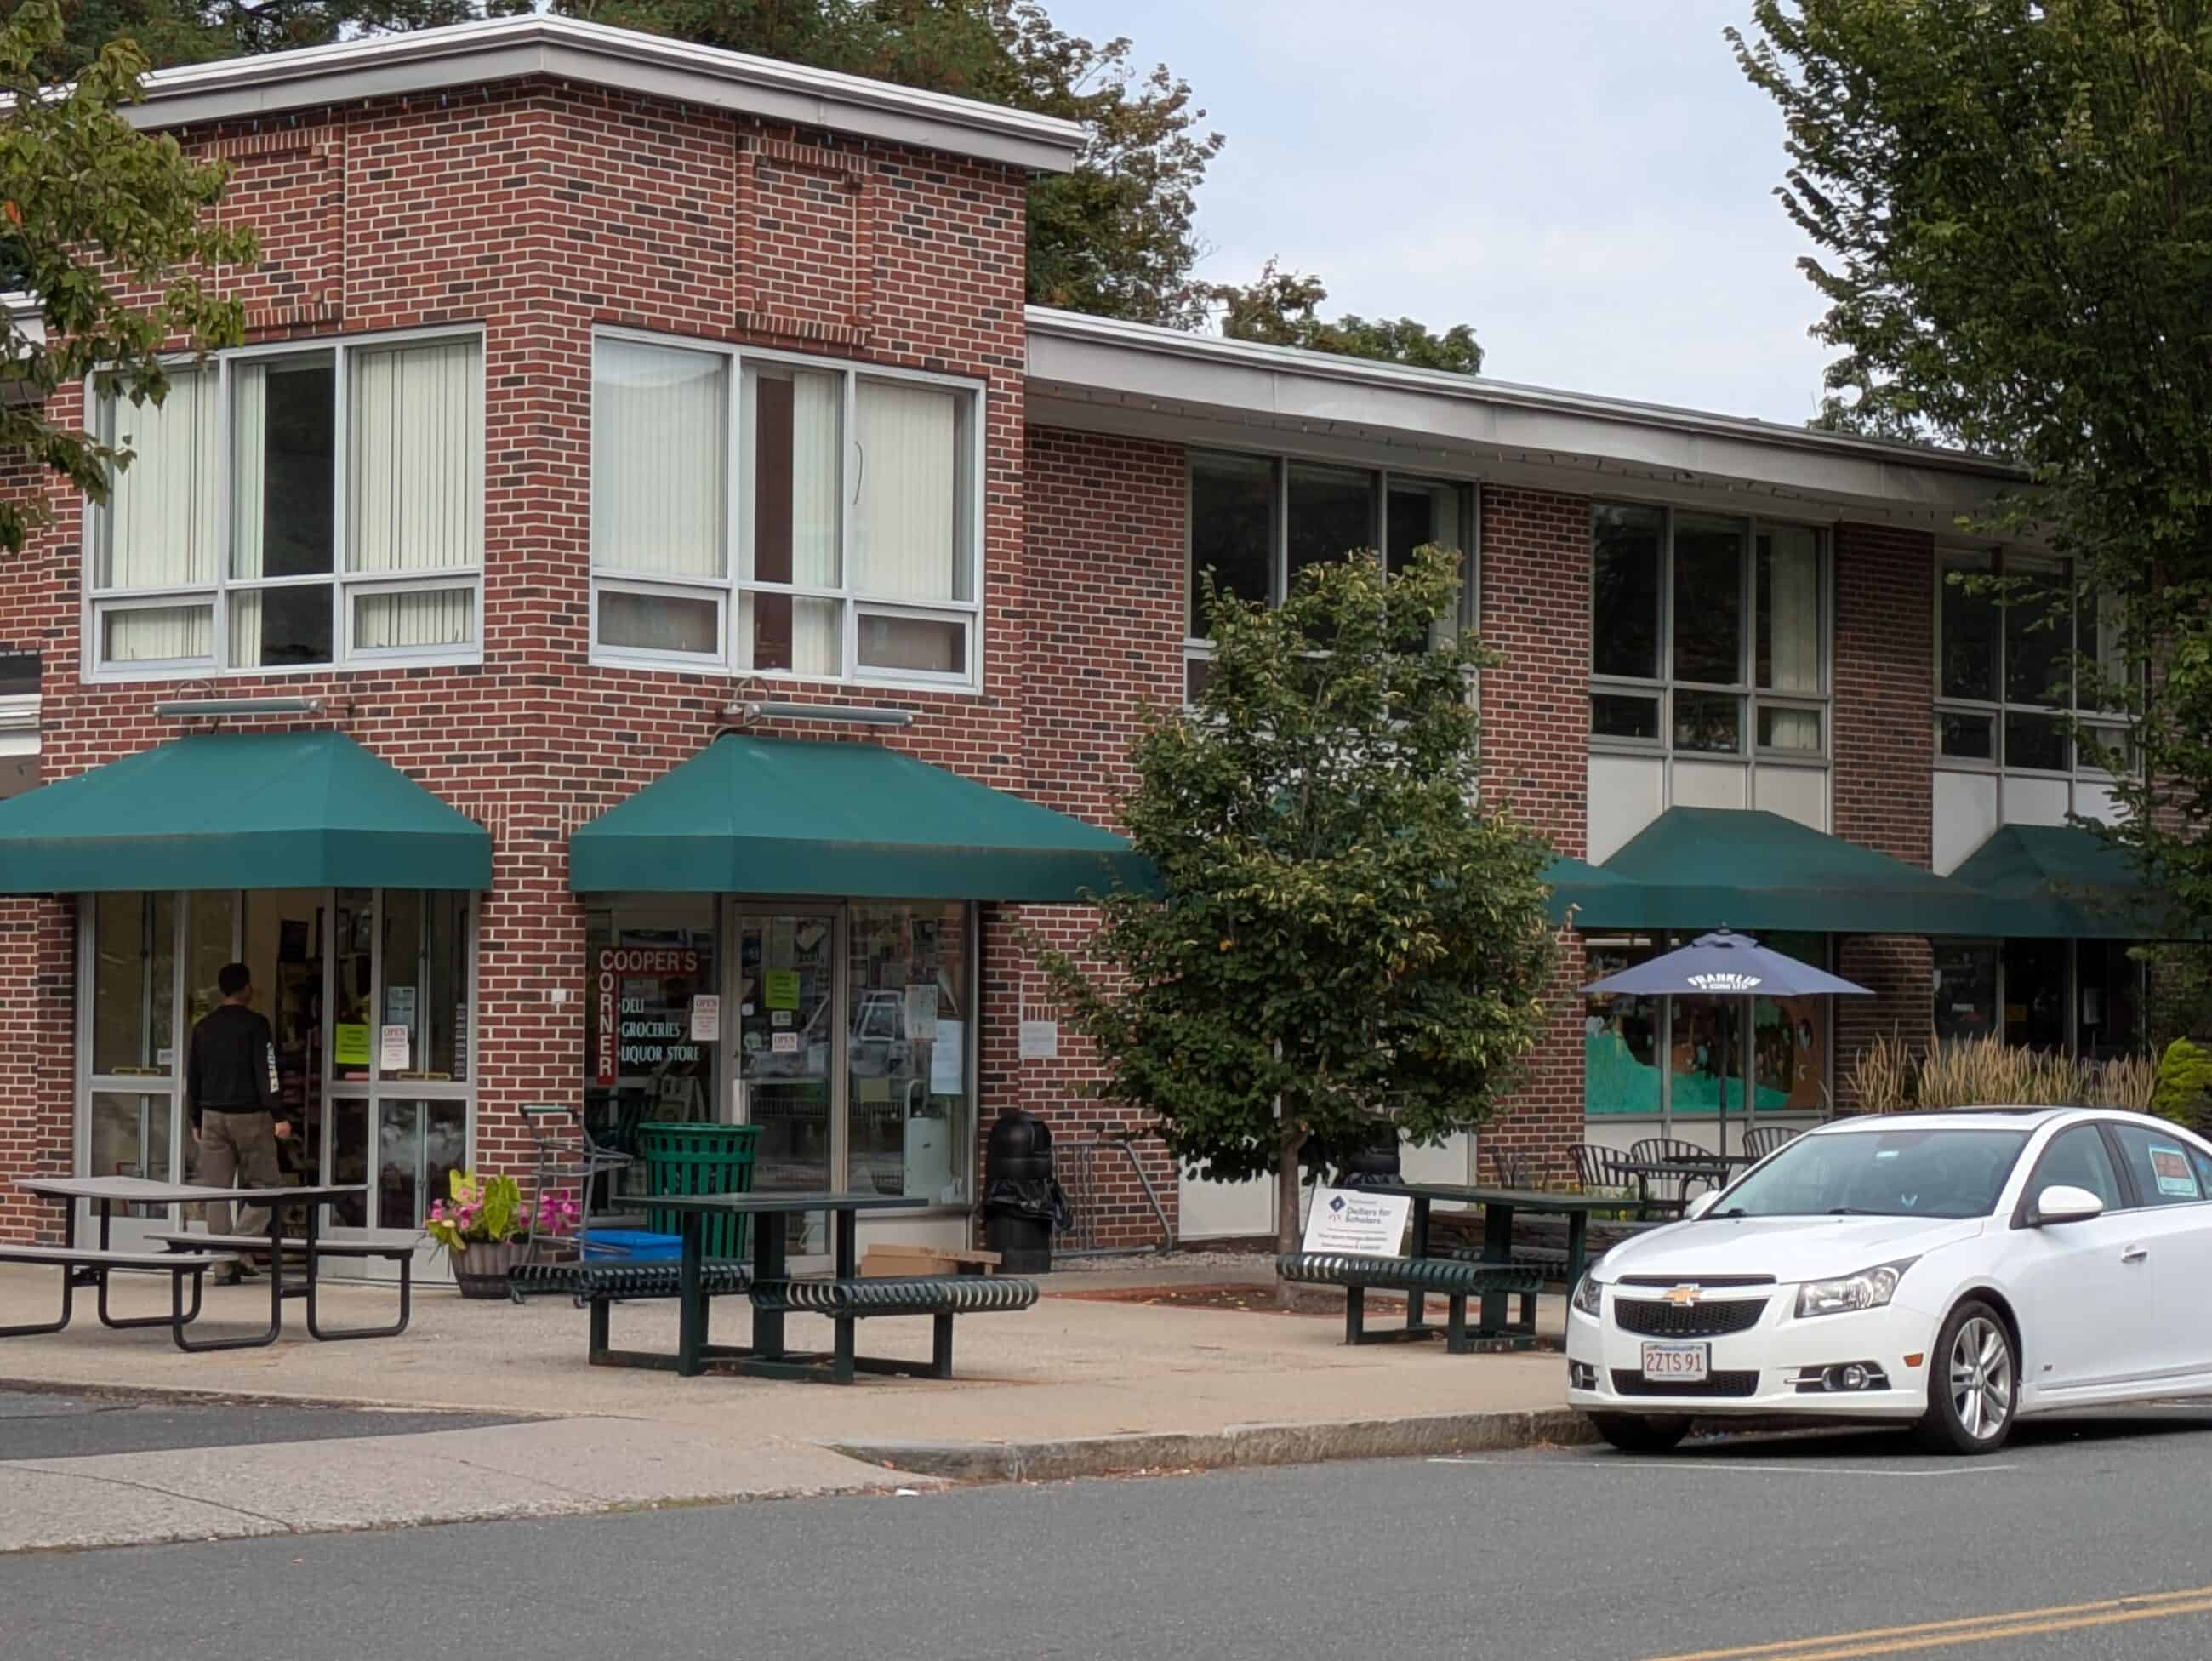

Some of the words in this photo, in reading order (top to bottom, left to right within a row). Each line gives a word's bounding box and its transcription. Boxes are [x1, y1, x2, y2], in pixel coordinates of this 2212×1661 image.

[599, 950, 698, 972] COOPER'S
[1687, 973, 1762, 986] FRANKLIN
[621, 997, 644, 1013] DELI
[695, 999, 718, 1008] OPEN
[598, 950, 614, 1076] CORNER
[383, 1027, 406, 1036] OPEN
[621, 1021, 681, 1037] GROCERIES
[621, 1045, 662, 1065] LIQUOR
[666, 1045, 700, 1061] STORE
[1646, 1353, 1682, 1372] 2ZTS
[1685, 1353, 1702, 1372] 91
